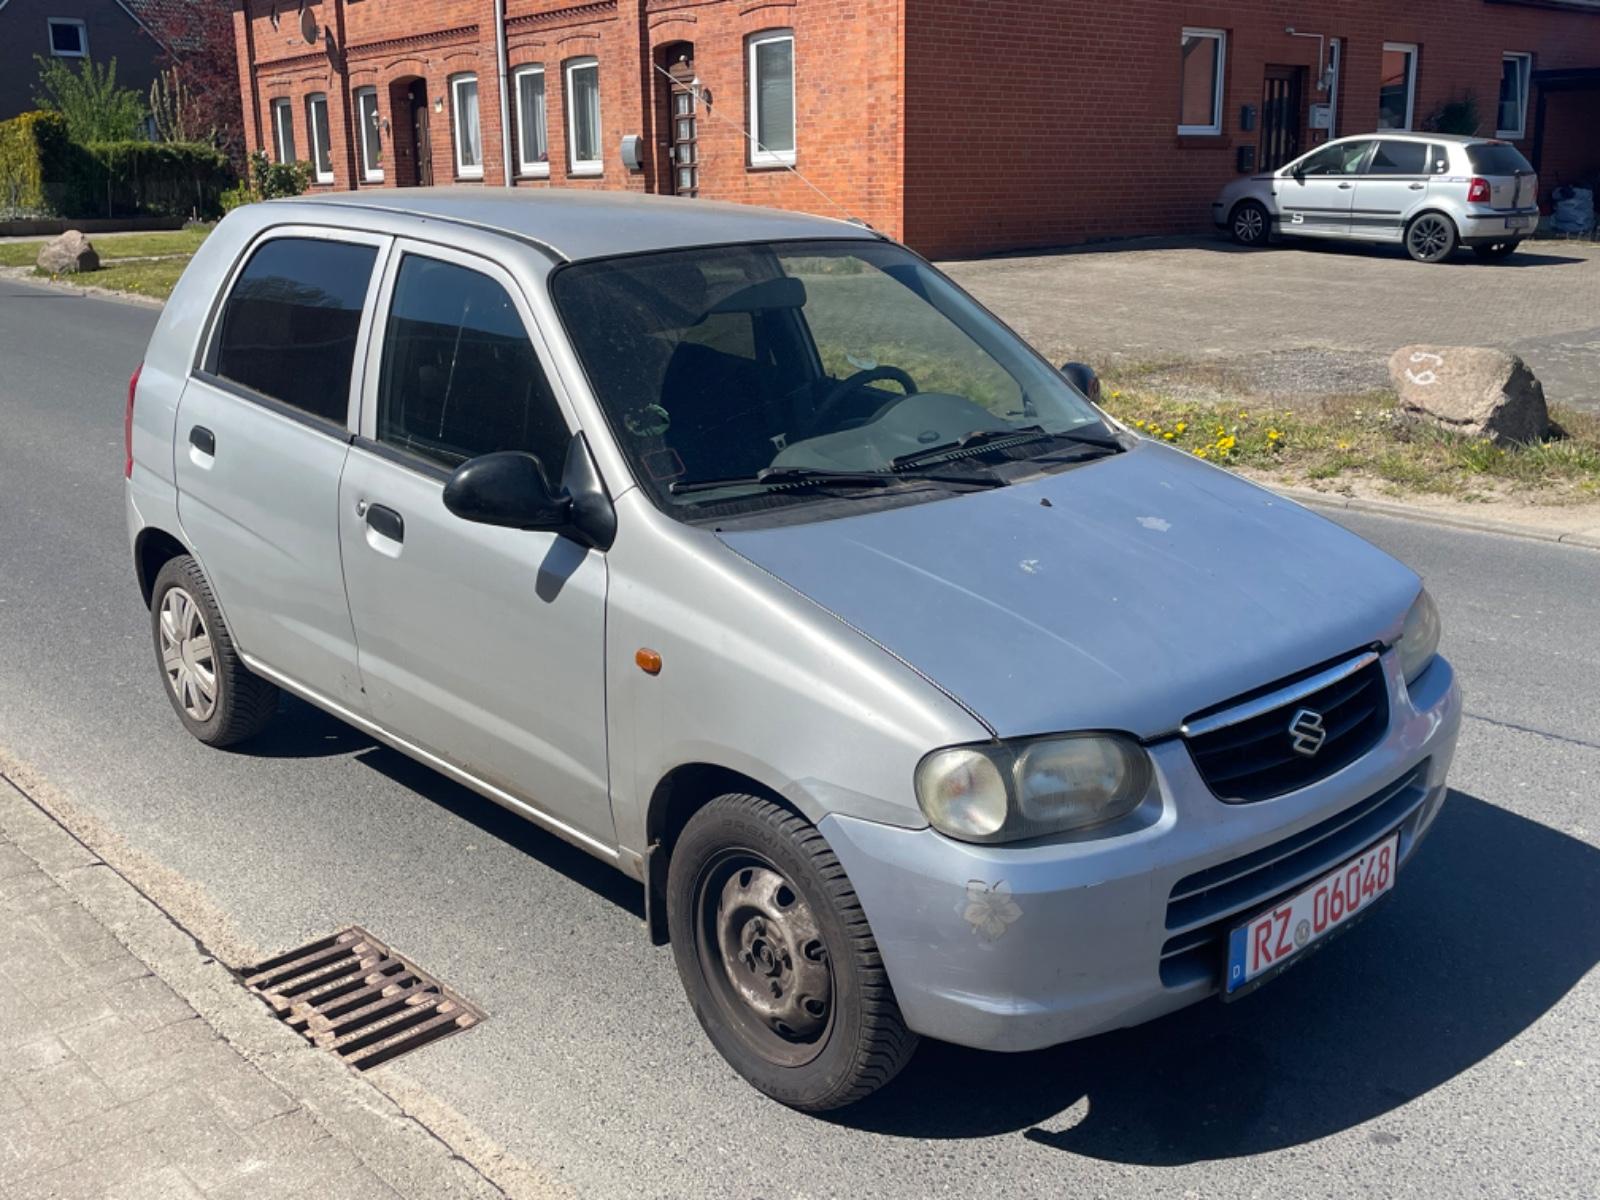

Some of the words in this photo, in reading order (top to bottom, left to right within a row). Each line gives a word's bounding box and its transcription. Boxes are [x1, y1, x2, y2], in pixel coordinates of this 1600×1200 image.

[1232, 964, 1241, 979] D
[1253, 906, 1293, 971] RZ
[1312, 845, 1391, 934] 06048
